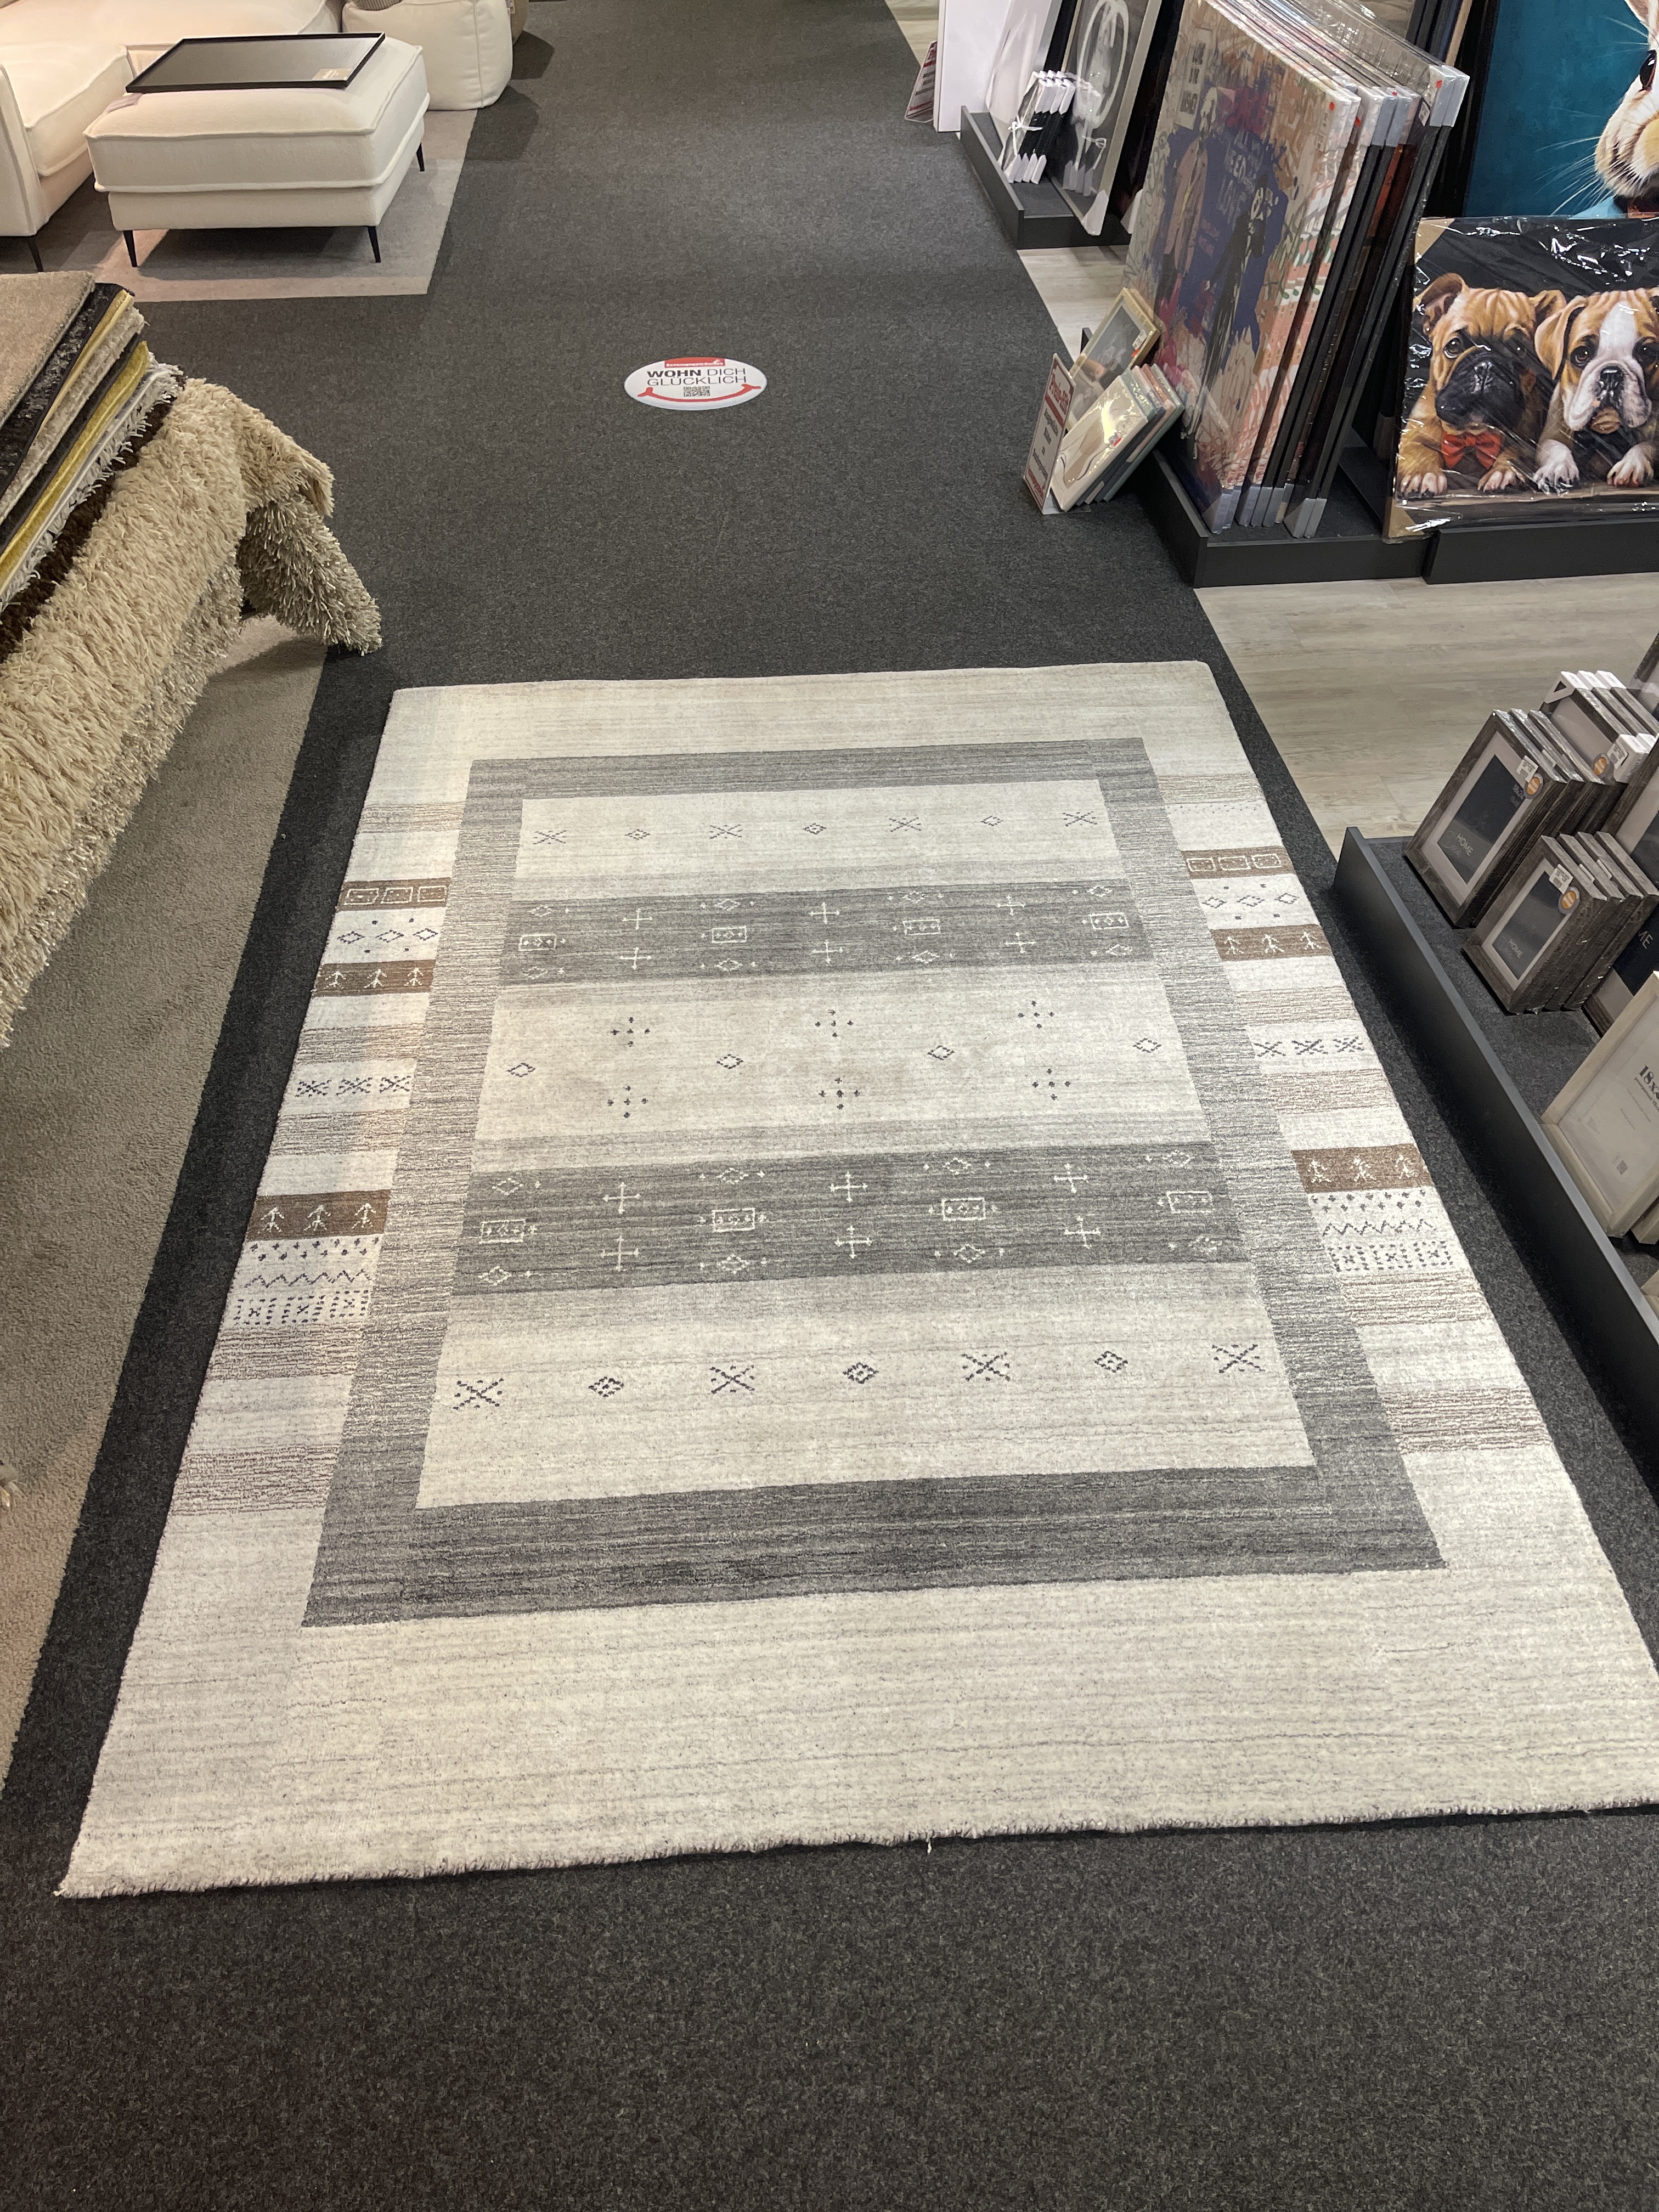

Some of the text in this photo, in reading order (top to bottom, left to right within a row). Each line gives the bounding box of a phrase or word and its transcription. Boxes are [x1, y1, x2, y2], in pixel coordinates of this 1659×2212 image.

[647, 368, 746, 378] WOHN DICH
[647, 375, 747, 386] GLÜCKLICH
[1457, 833, 1474, 856] HOME
[1509, 939, 1523, 958] HOME
